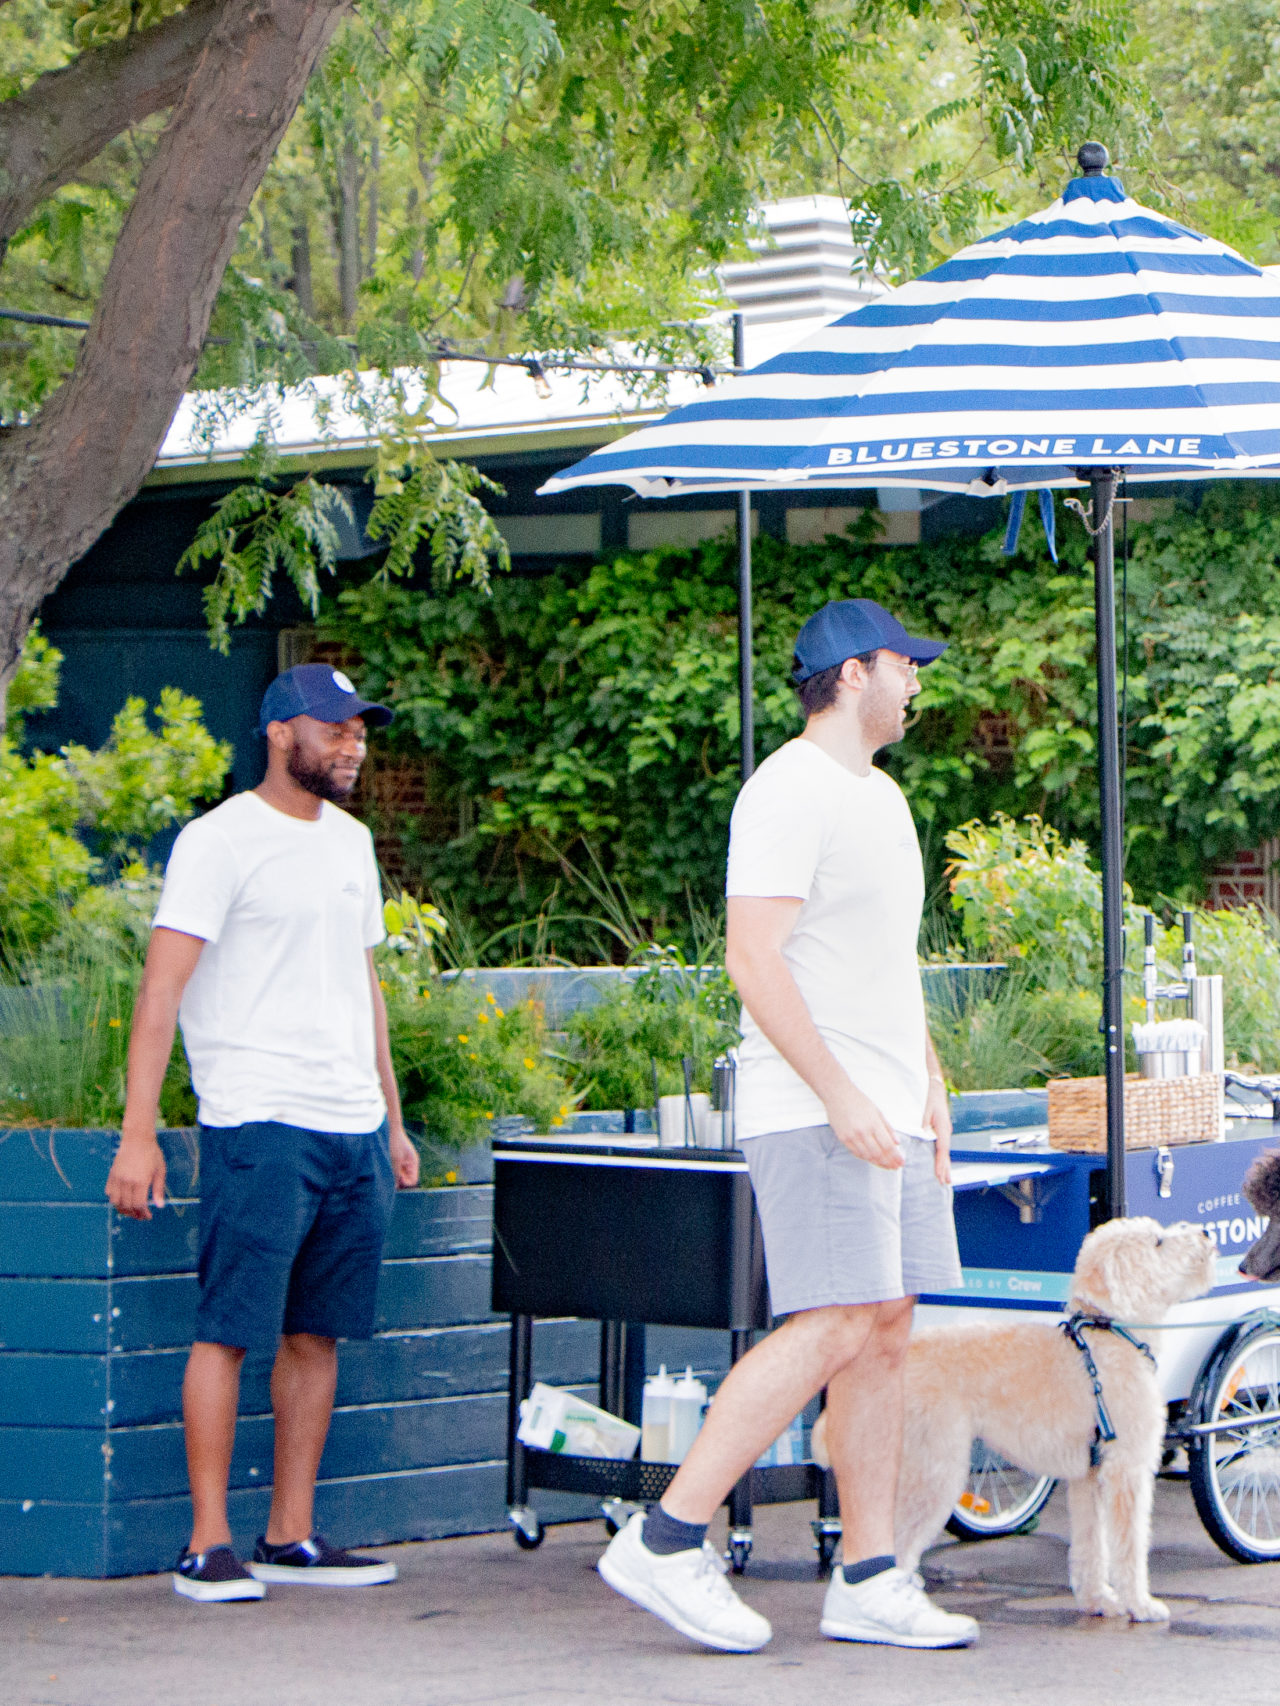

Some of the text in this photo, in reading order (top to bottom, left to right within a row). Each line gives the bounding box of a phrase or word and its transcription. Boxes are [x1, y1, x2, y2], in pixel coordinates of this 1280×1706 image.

[827, 437, 1202, 466] BLUESTONE LANE
[1197, 1192, 1240, 1214] COFFEE
[1008, 1276, 1042, 1292] Crew
